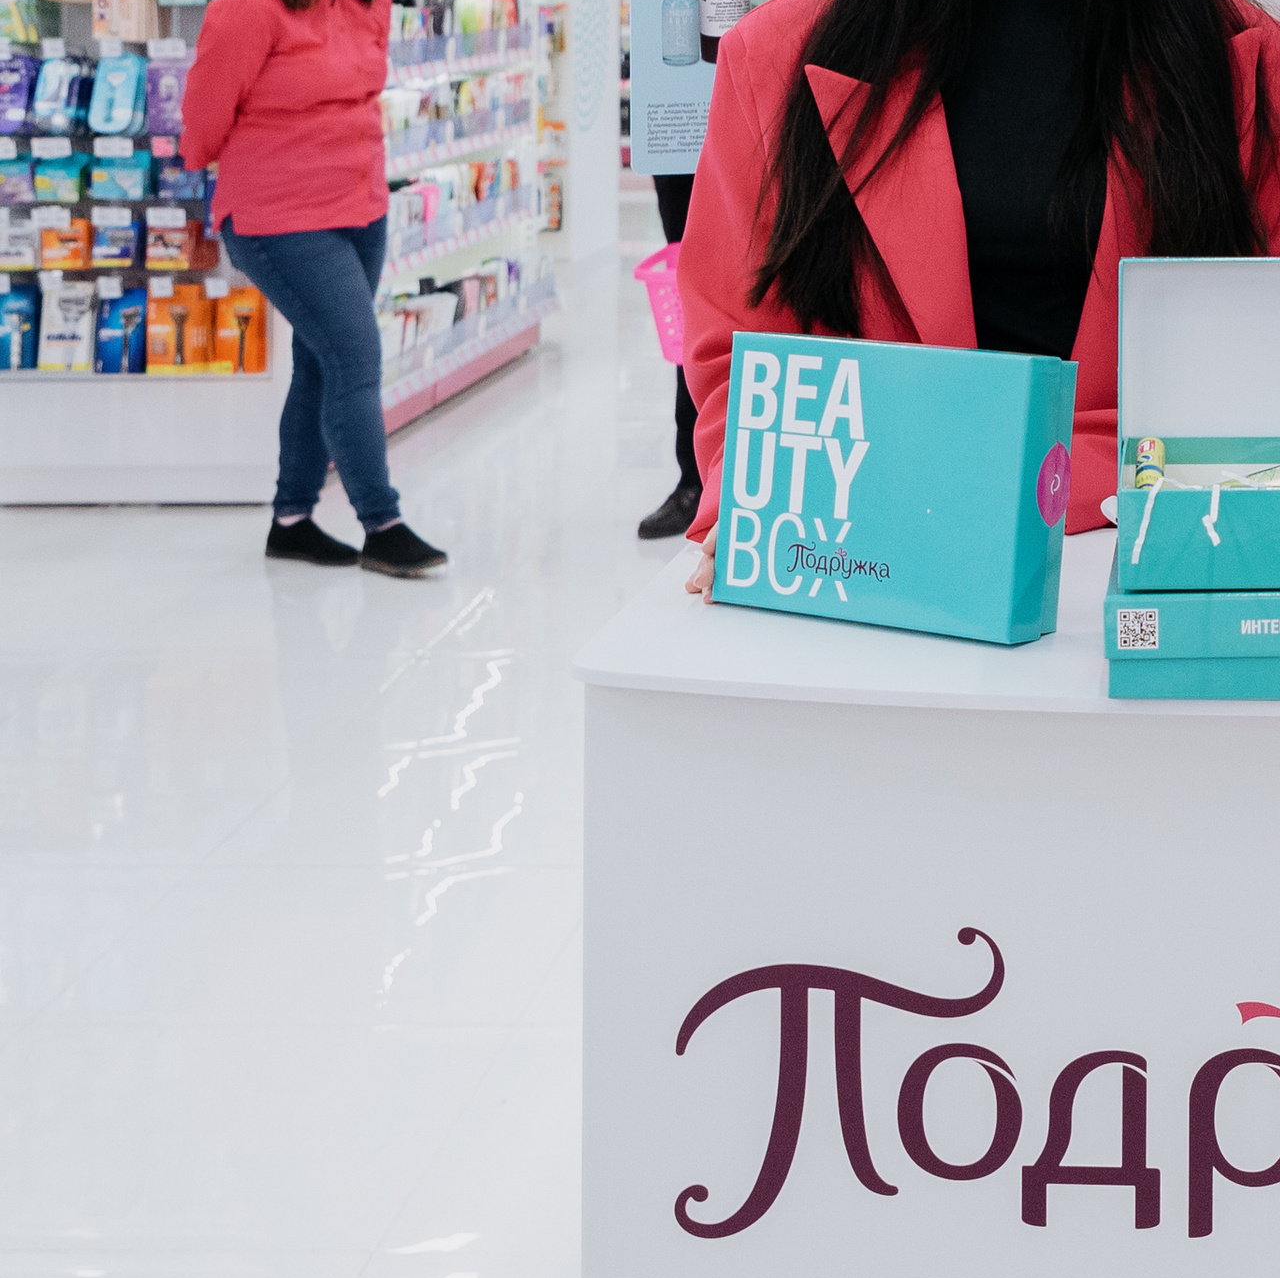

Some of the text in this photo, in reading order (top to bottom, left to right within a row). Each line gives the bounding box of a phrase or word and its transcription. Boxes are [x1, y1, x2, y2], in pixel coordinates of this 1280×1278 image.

[738, 350, 865, 440] BEA
[733, 428, 870, 520] UTY
[786, 541, 890, 582] Подружка
